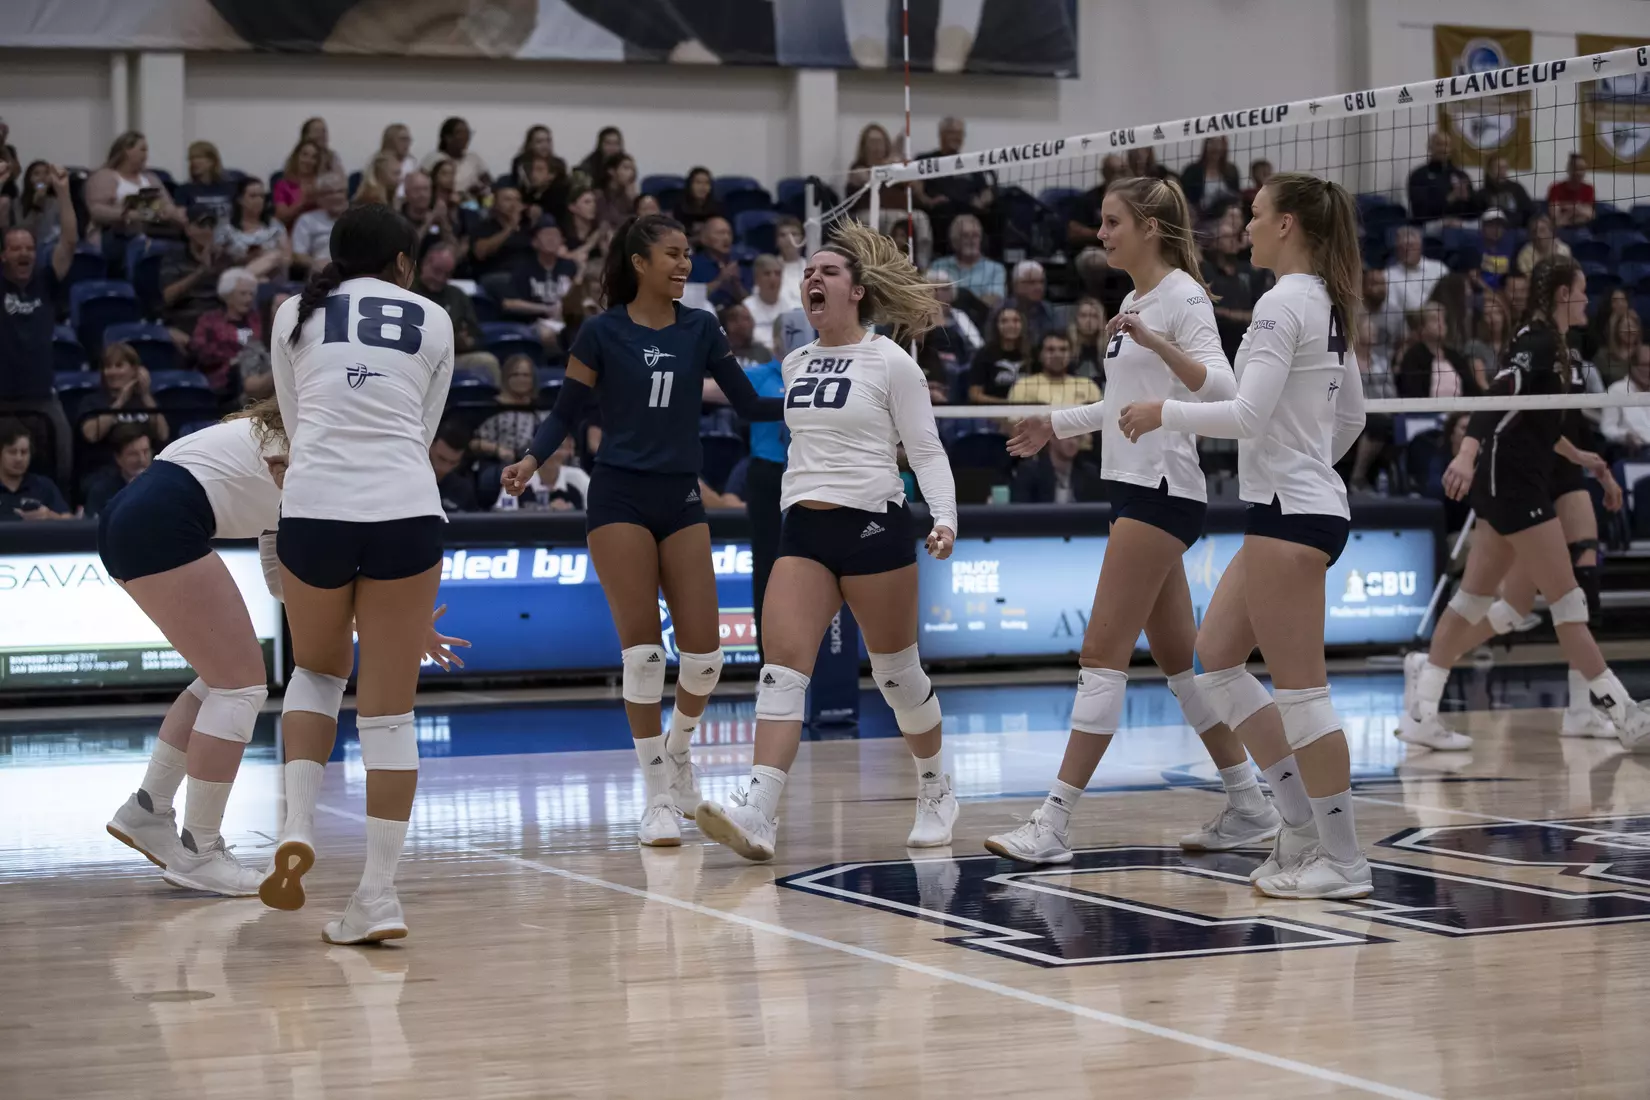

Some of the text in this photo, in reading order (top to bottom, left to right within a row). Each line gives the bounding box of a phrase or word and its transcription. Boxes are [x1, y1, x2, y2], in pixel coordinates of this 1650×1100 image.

[918, 159, 940, 175] CBU
[979, 139, 1066, 166] #LANCEUP
[1110, 128, 1135, 147] CBU
[1183, 104, 1289, 136] #LANCEUP
[1344, 90, 1377, 111] CBU
[1435, 60, 1567, 98] #LANCEUP
[318, 294, 425, 355] 18
[1253, 319, 1276, 330] WAC
[805, 358, 854, 374] CBU
[648, 371, 674, 407] 11
[786, 377, 851, 409] 20
[0, 564, 115, 590] SAVA
[532, 548, 588, 585] by
[952, 560, 999, 575] ENJOY
[952, 574, 999, 594] FREE
[1366, 571, 1417, 596] CBU
